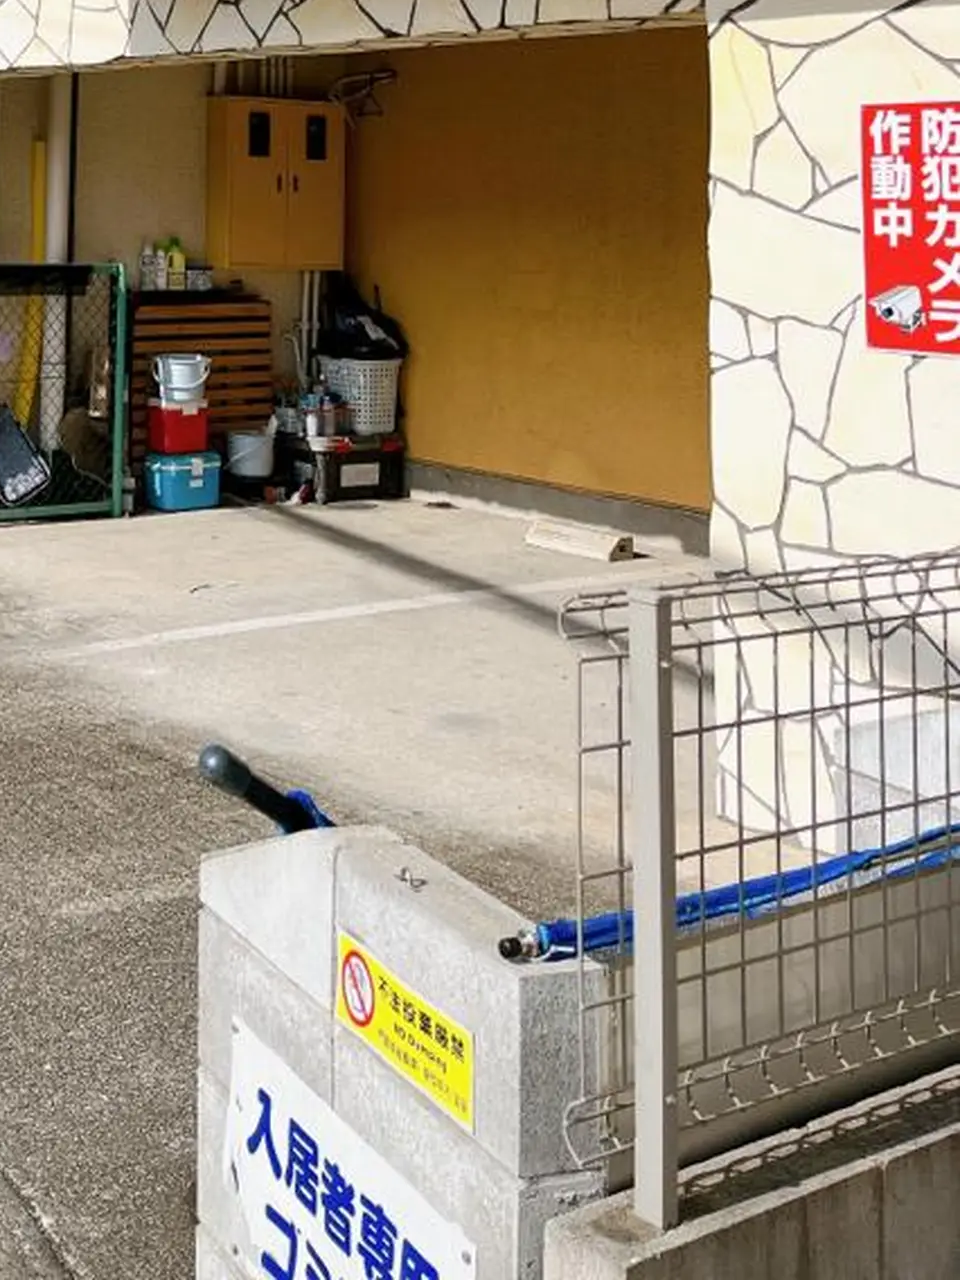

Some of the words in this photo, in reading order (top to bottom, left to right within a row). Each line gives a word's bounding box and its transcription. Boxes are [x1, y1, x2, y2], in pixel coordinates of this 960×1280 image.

[869, 109, 913, 247] 作動中
[920, 107, 960, 342] 防犯カメラ
